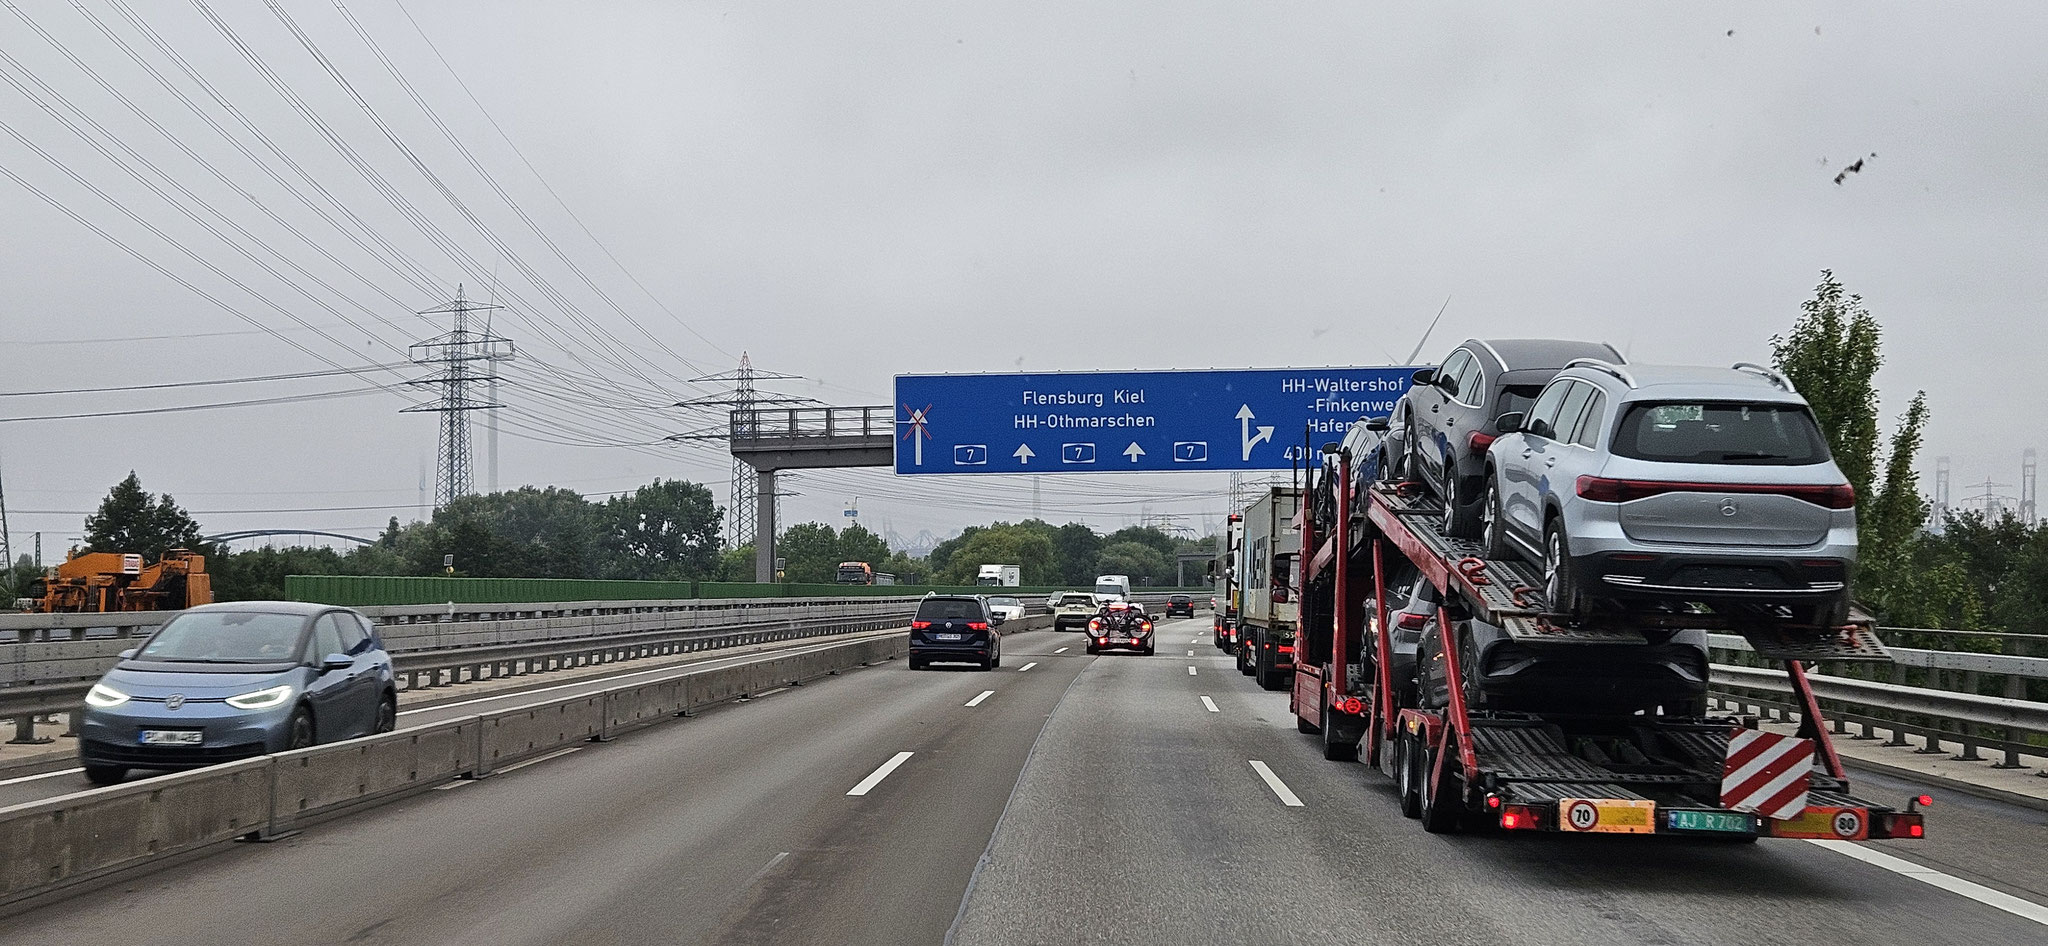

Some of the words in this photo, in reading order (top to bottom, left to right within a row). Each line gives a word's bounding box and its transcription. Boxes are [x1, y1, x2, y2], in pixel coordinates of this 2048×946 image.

[1282, 377, 1404, 393] HH-Waltershof
[1023, 391, 1104, 407] Flensburg
[1114, 389, 1145, 404] Kiel
[1307, 398, 1395, 412] -Finkenwe
[1014, 413, 1155, 429] HH-Othmarschen
[967, 449, 974, 460] 7
[1075, 448, 1082, 459] 7
[1186, 446, 1194, 458] 7
[1575, 809, 1590, 822] 70
[1839, 817, 1855, 830] 80
